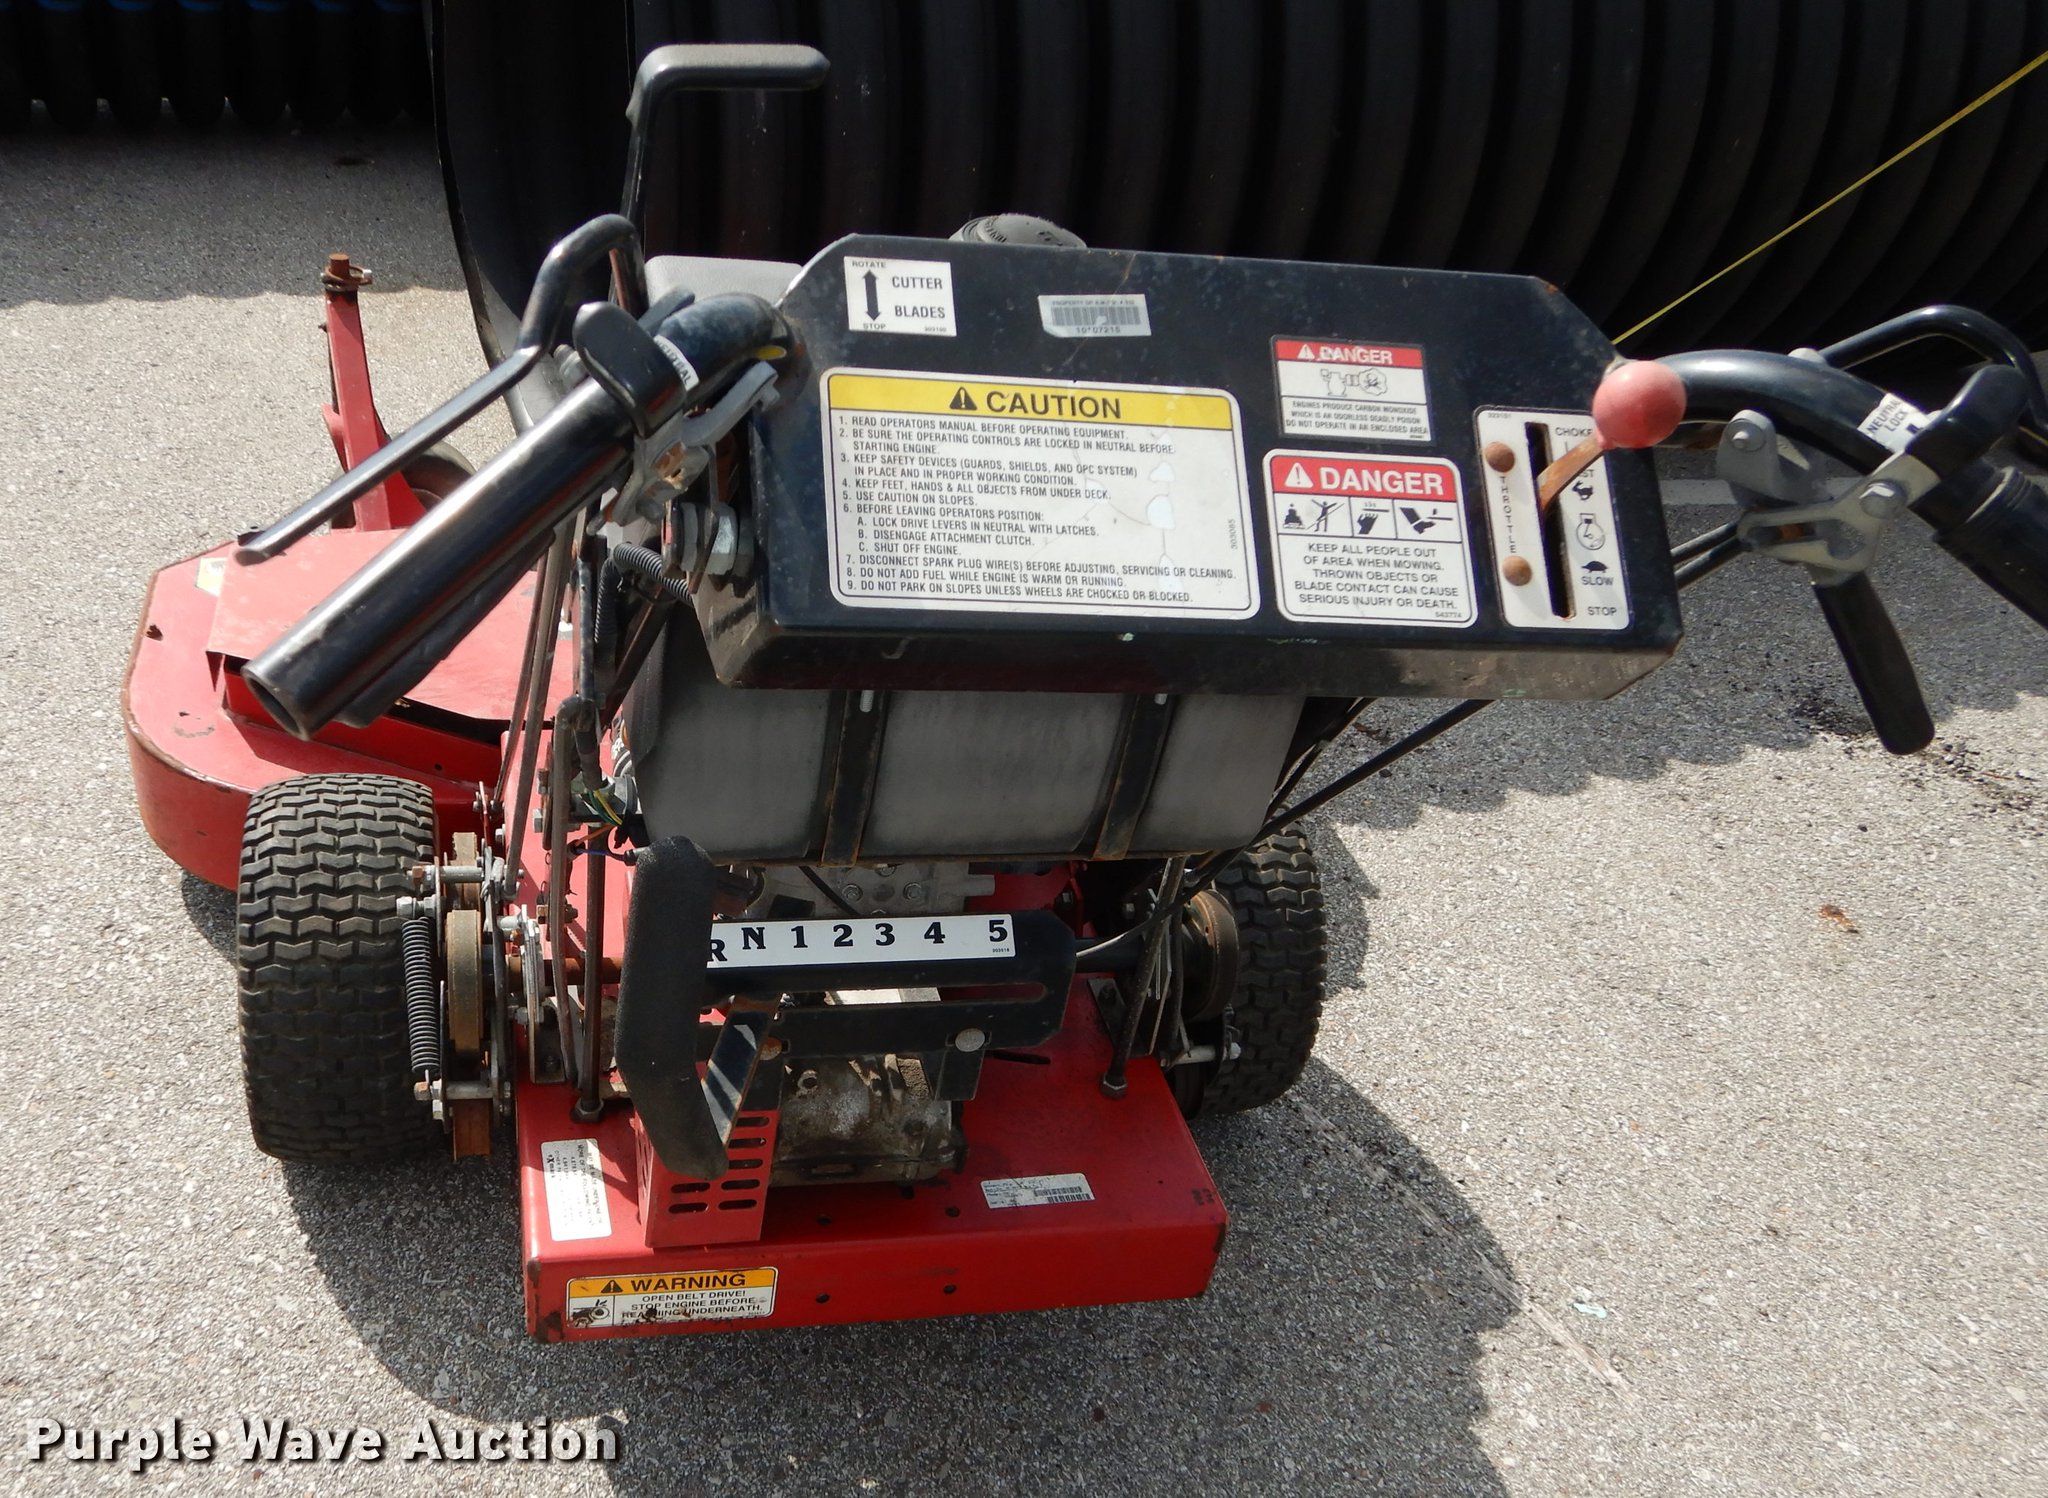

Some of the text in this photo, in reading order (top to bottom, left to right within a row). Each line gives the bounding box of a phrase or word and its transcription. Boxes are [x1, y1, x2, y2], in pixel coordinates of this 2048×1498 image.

[892, 276, 943, 289] CUTTER
[895, 305, 945, 319] BLADES
[1319, 345, 1392, 365] DANGER
[986, 391, 1121, 419] CAUTION
[1314, 420, 1346, 429] OPERATE
[1867, 400, 1901, 433] NEUTRAL
[1884, 410, 1908, 432] LOCK
[851, 415, 1127, 439] READ OPERATORS MANUAL BEFORE OPERATING EQUIPMENT.
[852, 428, 1173, 454] BE SURE THE OPERATING CONTROLS ARE LOCKED IN NEUTRAL BEFORE
[852, 440, 938, 454] STARTING ENGINE.
[853, 453, 1137, 476] KEEP SAFETY DEVICES (GUARDS, SHIELDS, AND OPC SYSTEM)
[854, 465, 1076, 485] IN PLACE AND IN PROPER WORKING CONDITION.
[1319, 466, 1444, 495] DANGER
[855, 478, 1111, 499] KEEP FEET, HANDS & ALL OBJECTS FROM UNDER DECK.
[856, 490, 977, 506] USE CAUTION ON SLOPES.
[856, 503, 1044, 521] BEFORE LEAVING OPERATORS POSITION:
[1499, 476, 1516, 553] THROTTLE
[872, 516, 1099, 536] LOCK DRIVE LEVERS IN NEUTRAL WITH LATCHES.
[873, 529, 1034, 546] DISENGAGE ATTACHMENT CLUTCH.
[874, 542, 960, 555] SHUT OFF ENGINE.
[1307, 542, 1437, 558] KEEP ALL PEOPLE OUT
[859, 554, 1236, 579] DISCONNECT SPARK PLUG WIRE(S) BEFORE ADJUSTING, SERVICING OR CLEANING.
[1303, 555, 1444, 570] OF AREA WHEN MOWING.
[860, 567, 1126, 587] DO NOT ADD FUEL WHILE ENGINE IS WARM OR RUNNING.
[1312, 568, 1438, 583] THROWN OBJECTS OR
[1581, 576, 1614, 586] SLOW
[860, 579, 1192, 602] DO NOT PARK ON SLOPES UNLESS WHEELS ARE CHOCKED OR BLOCKED.
[1294, 580, 1459, 597] BLADE CONTACT CAN CAUSE
[1298, 593, 1456, 609] SERIOUS INJURY OR DEATH.
[1588, 606, 1617, 616] STOP
[741, 927, 766, 950] N
[791, 925, 808, 948] 1
[833, 924, 853, 947] 2
[875, 923, 895, 946] 3
[924, 922, 946, 943] 4
[989, 920, 1008, 942] 5
[631, 1274, 746, 1292] WARNING
[631, 1297, 753, 1311] STOP ENGINE BEFORE
[642, 1290, 746, 1302] OPEN BELT DRIVE!
